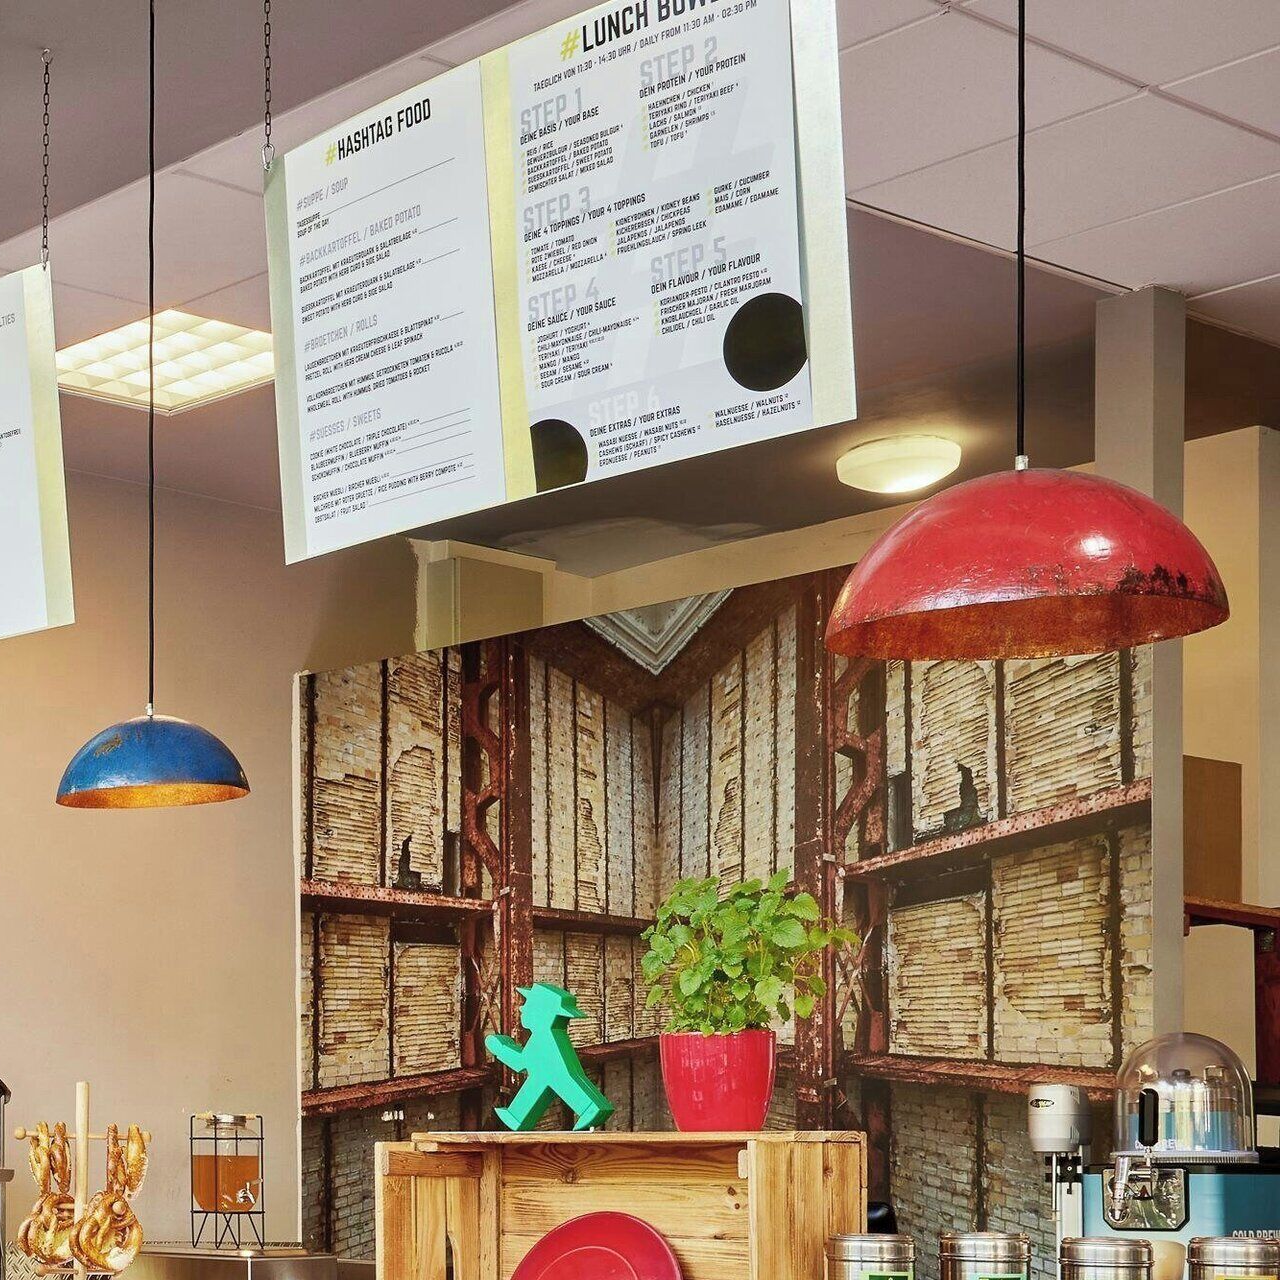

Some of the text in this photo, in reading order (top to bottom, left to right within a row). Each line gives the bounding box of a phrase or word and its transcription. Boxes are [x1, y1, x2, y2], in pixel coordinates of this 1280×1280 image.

[533, 0, 757, 92] TAEGLICH VON 11:30 14:30 UHR DAILY FROM 11:30 AM 02:30 PM
[560, 2, 649, 60] #LUNCH
[639, 34, 718, 90] STEP 2
[639, 51, 745, 99] DEIN PROTEIN YOUR PROTEIN
[520, 87, 582, 135] STEP 1
[648, 81, 710, 111] HAEHNCHEN CHICKEN
[648, 83, 733, 120] TERIYAKI RIND TERIYAKI BEEF
[324, 97, 430, 166] #HASHTAG FOOD
[520, 105, 599, 145] DEINE BASIS YOUR BASE
[649, 107, 696, 130] LACHS SALMON
[649, 112, 709, 139] GARNELEN SHRIMPS
[650, 131, 684, 149] TOFU TOFU
[330, 175, 348, 195] SOUP
[713, 170, 769, 195] GURKE CUCUMBER
[714, 186, 750, 204] MAIS CORN
[714, 187, 778, 214] EDAMAME EDAMAME
[522, 184, 590, 233] STEP 3
[523, 192, 645, 242] DEINE 4 TOPPINGS YOUR 4 TOPPINGS
[298, 203, 420, 267] #BACKKARTOFFEL BAKED POTATO
[649, 236, 726, 286] STEP 5
[651, 252, 760, 294] DEIN FLAVOUR YOUR FLAVOUR
[527, 276, 599, 323] STEP 4
[527, 296, 616, 332] DEINE SAUCE YOUR SAUCE
[356, 313, 377, 333] ROLLS
[352, 407, 381, 427] SWEETS
[589, 405, 680, 437] DEINE EXTRAS YOUR EXTRAS
[714, 395, 783, 418] WALNUESSE WALNUTS
[715, 402, 795, 427] HASELNUESSE HAZELNUTS
